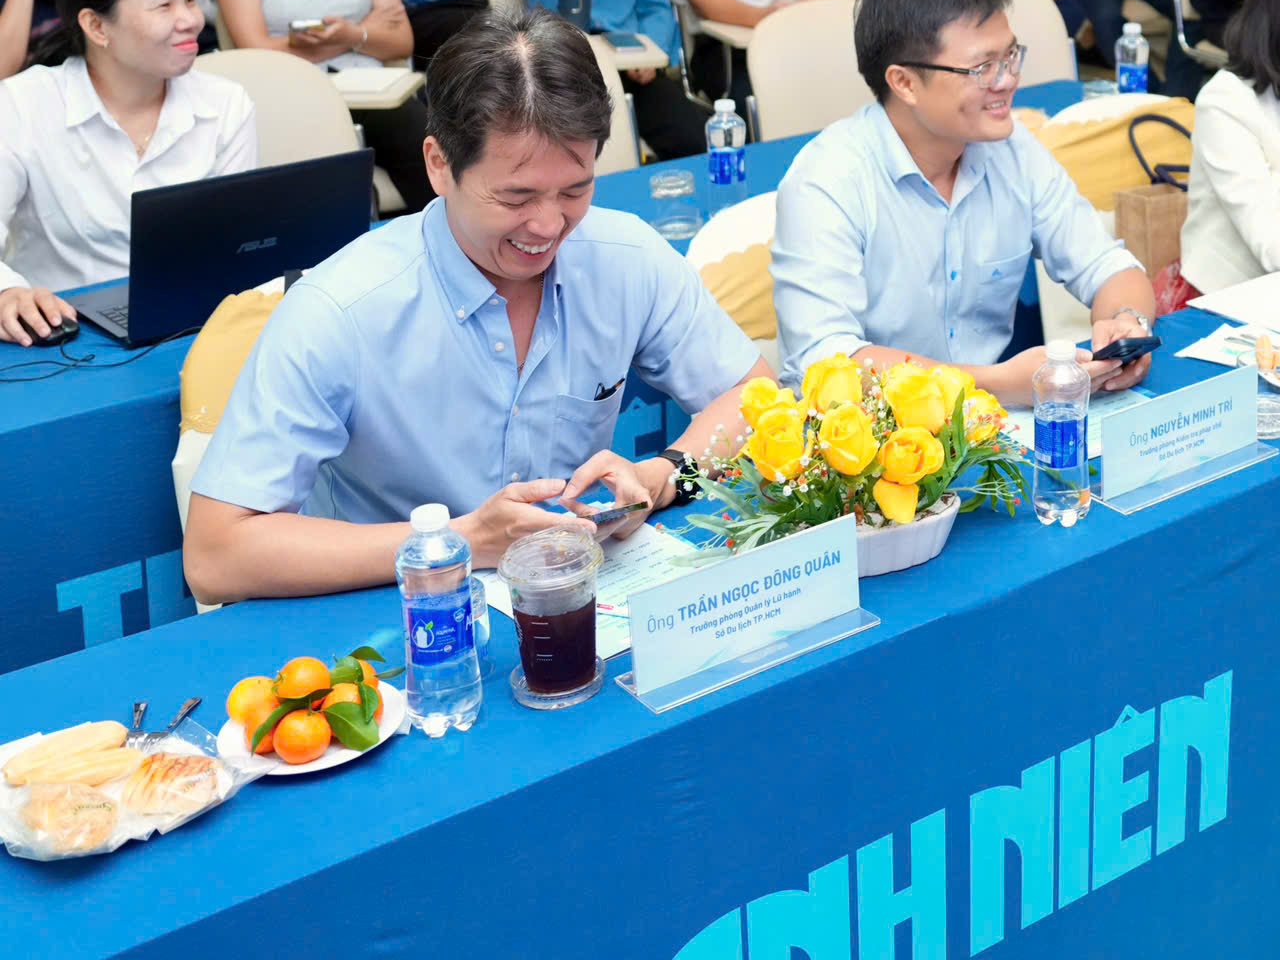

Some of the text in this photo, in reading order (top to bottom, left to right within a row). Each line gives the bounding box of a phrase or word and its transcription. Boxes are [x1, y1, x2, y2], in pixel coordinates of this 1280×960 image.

[236, 237, 277, 254] ASUS
[1129, 431, 1148, 447] Ông
[1150, 412, 1191, 439] NGUYỄN
[1192, 405, 1215, 424] MINH
[647, 550, 841, 634] Ông TRẦN NGỌC ĐÔNG QUÂN
[690, 617, 718, 634] Trưởng
[719, 609, 743, 627] phòng
[744, 601, 763, 616] Quản
[764, 597, 771, 610] lý
[783, 588, 802, 601] hành
[715, 608, 781, 639] Sở Du lịch TP.HCM
[969, 669, 1233, 958] NIÊN
